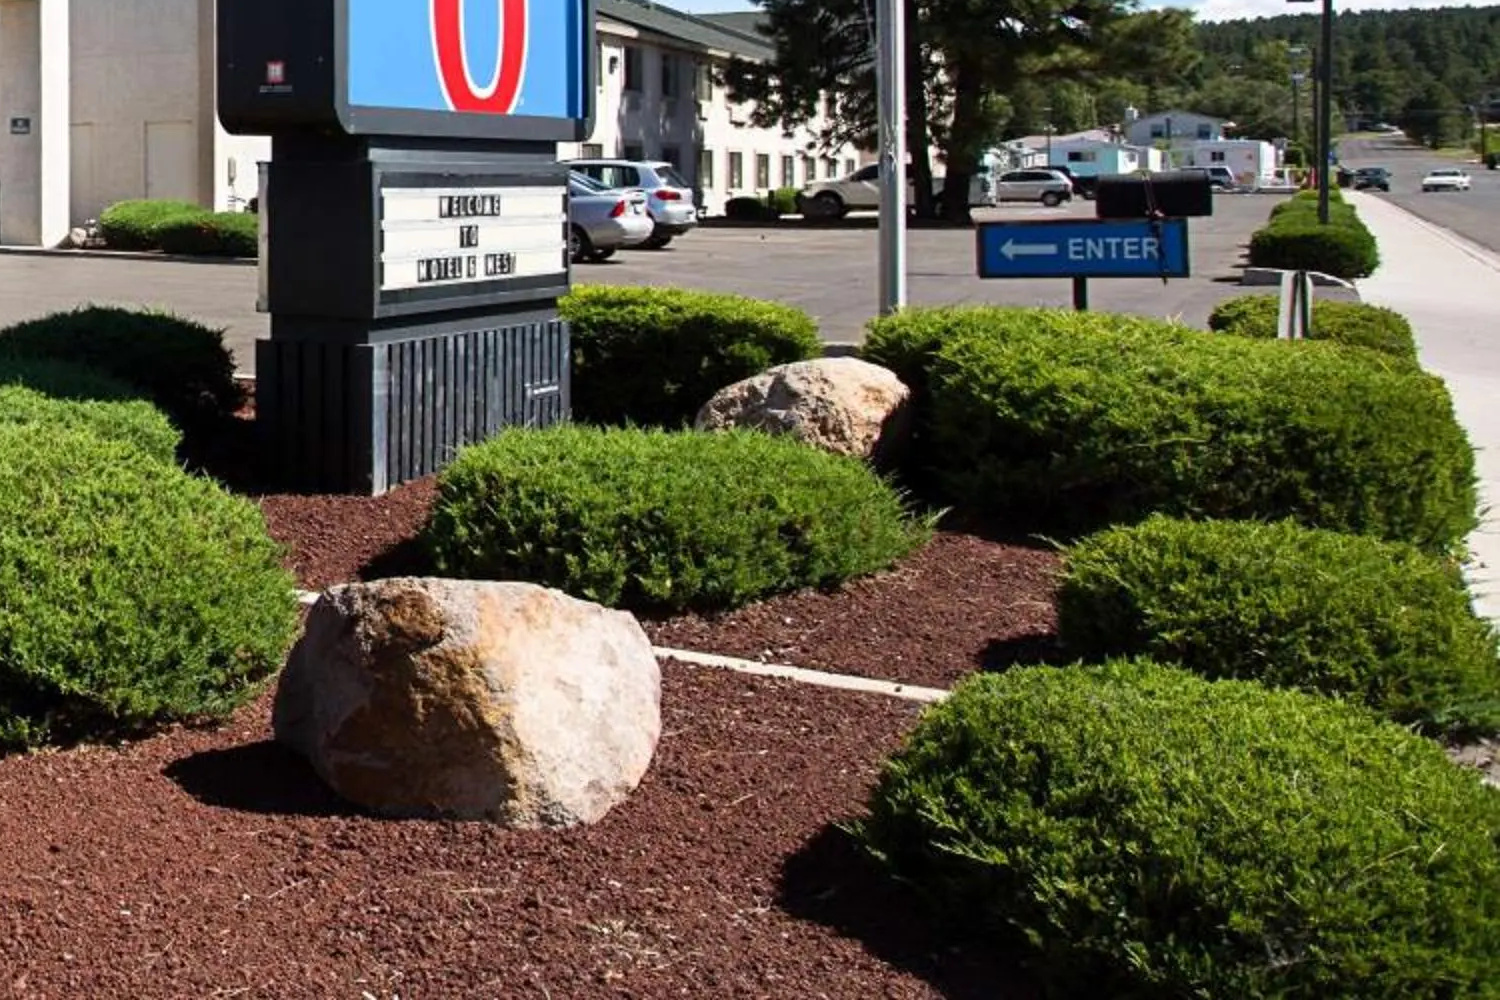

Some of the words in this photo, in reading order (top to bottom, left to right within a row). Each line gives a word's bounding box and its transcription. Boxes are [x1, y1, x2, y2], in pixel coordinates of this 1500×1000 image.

[440, 195, 500, 217] WELCOME
[461, 226, 478, 247] TO
[1068, 237, 1159, 260] ENTER
[419, 257, 462, 281] MOTEL
